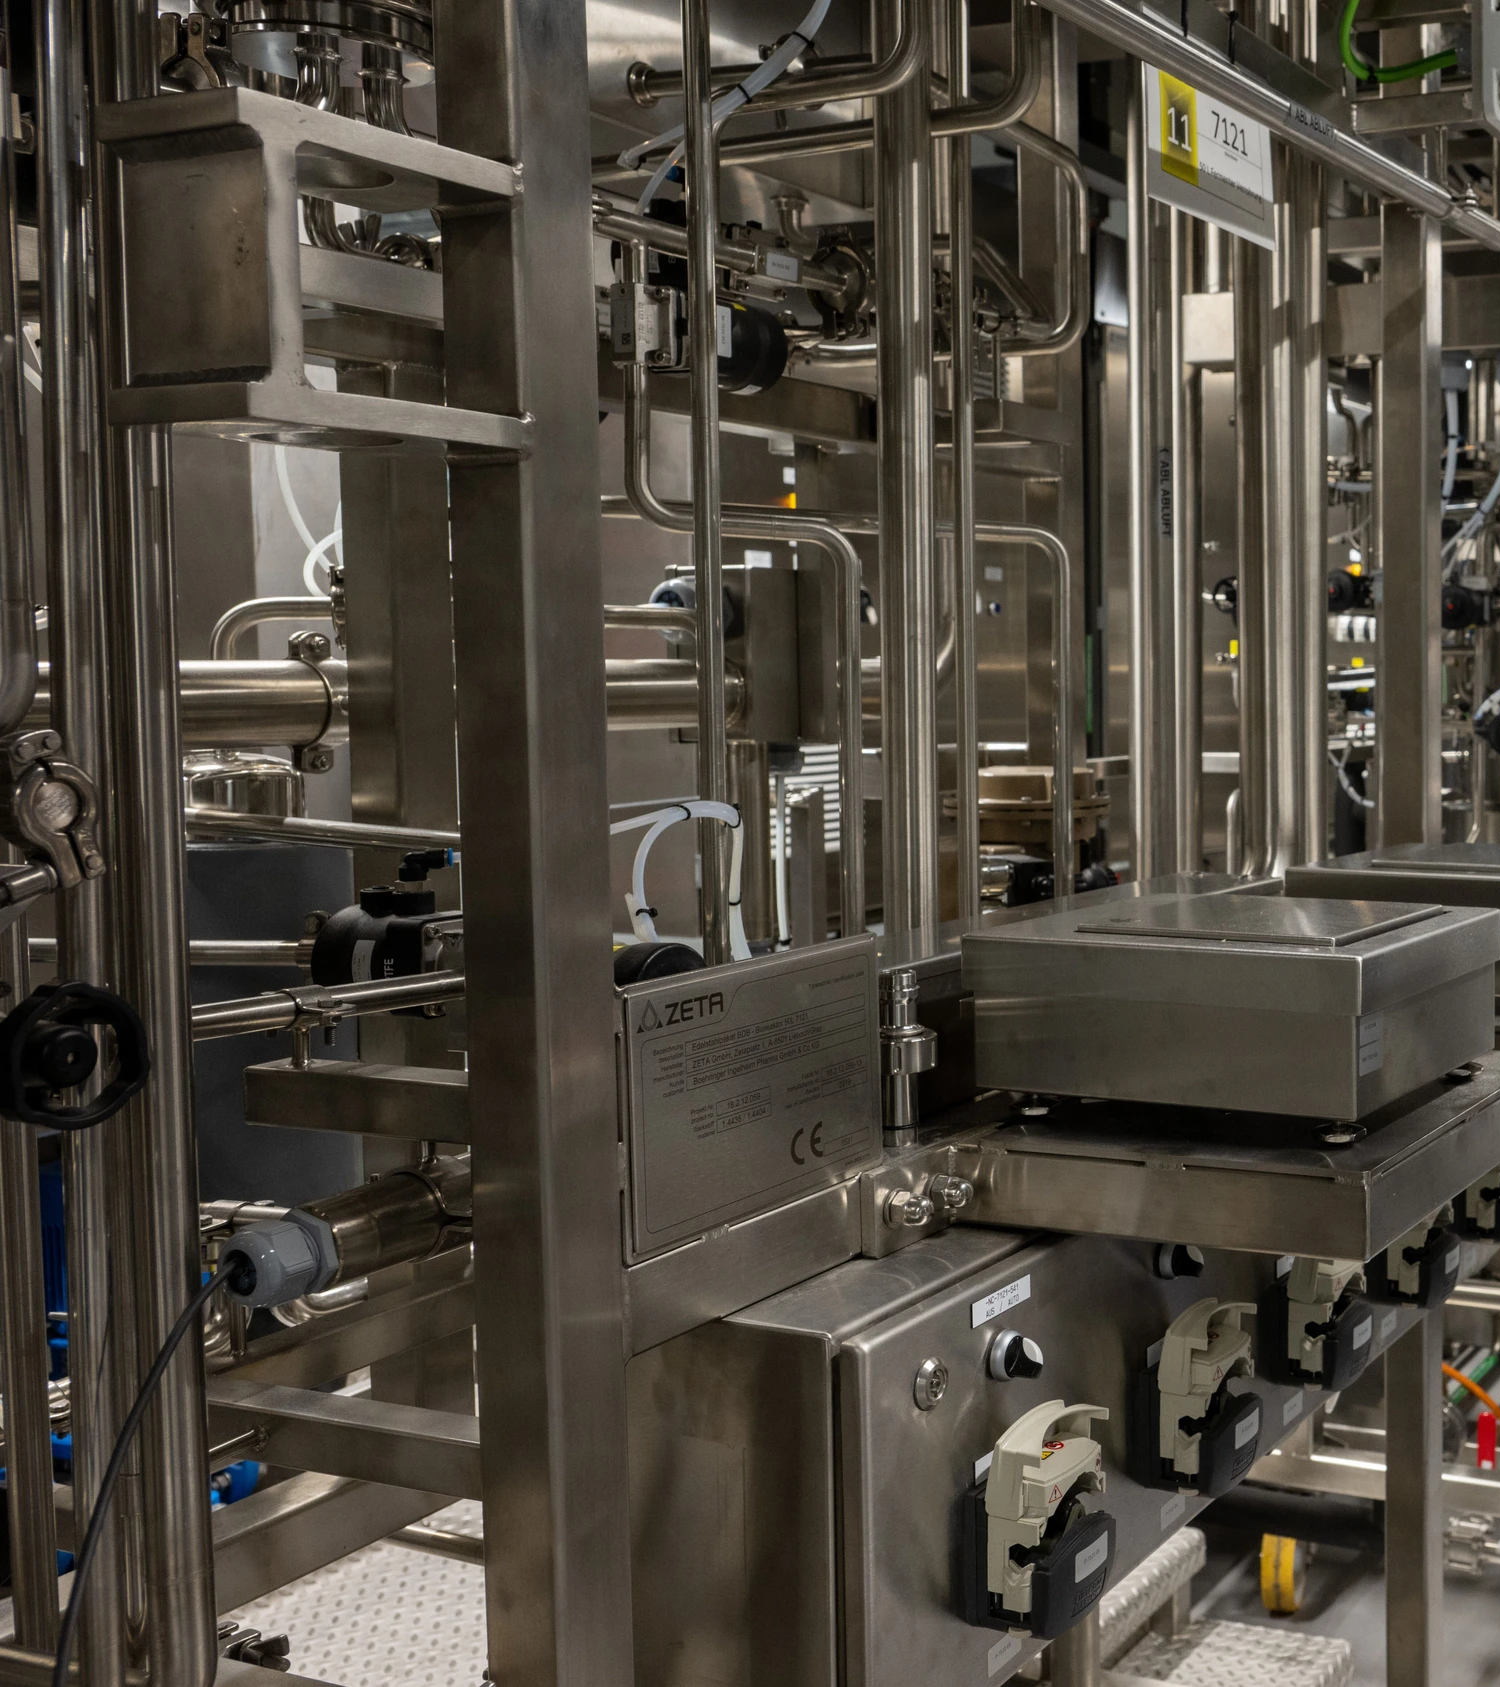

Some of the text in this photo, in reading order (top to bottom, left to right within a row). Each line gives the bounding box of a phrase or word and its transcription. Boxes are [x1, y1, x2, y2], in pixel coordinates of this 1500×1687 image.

[1168, 107, 1192, 152] 11
[1211, 110, 1248, 156] 7121
[1160, 460, 1171, 536] ABL ABLUFT
[384, 958, 394, 980] TFE
[665, 992, 723, 1026] ZETA
[691, 1031, 735, 1051] Edelstahlpaket
[755, 1018, 783, 1034] Bioreaktor
[795, 1011, 808, 1022] 7121
[692, 1055, 710, 1069] ZETA
[693, 1040, 819, 1085] Boehringer Ingelheim Pharma GmbH & Co KG
[791, 1121, 823, 1165] CE
[986, 1307, 995, 1318] AUS
[1008, 1294, 1019, 1306] AUTO
